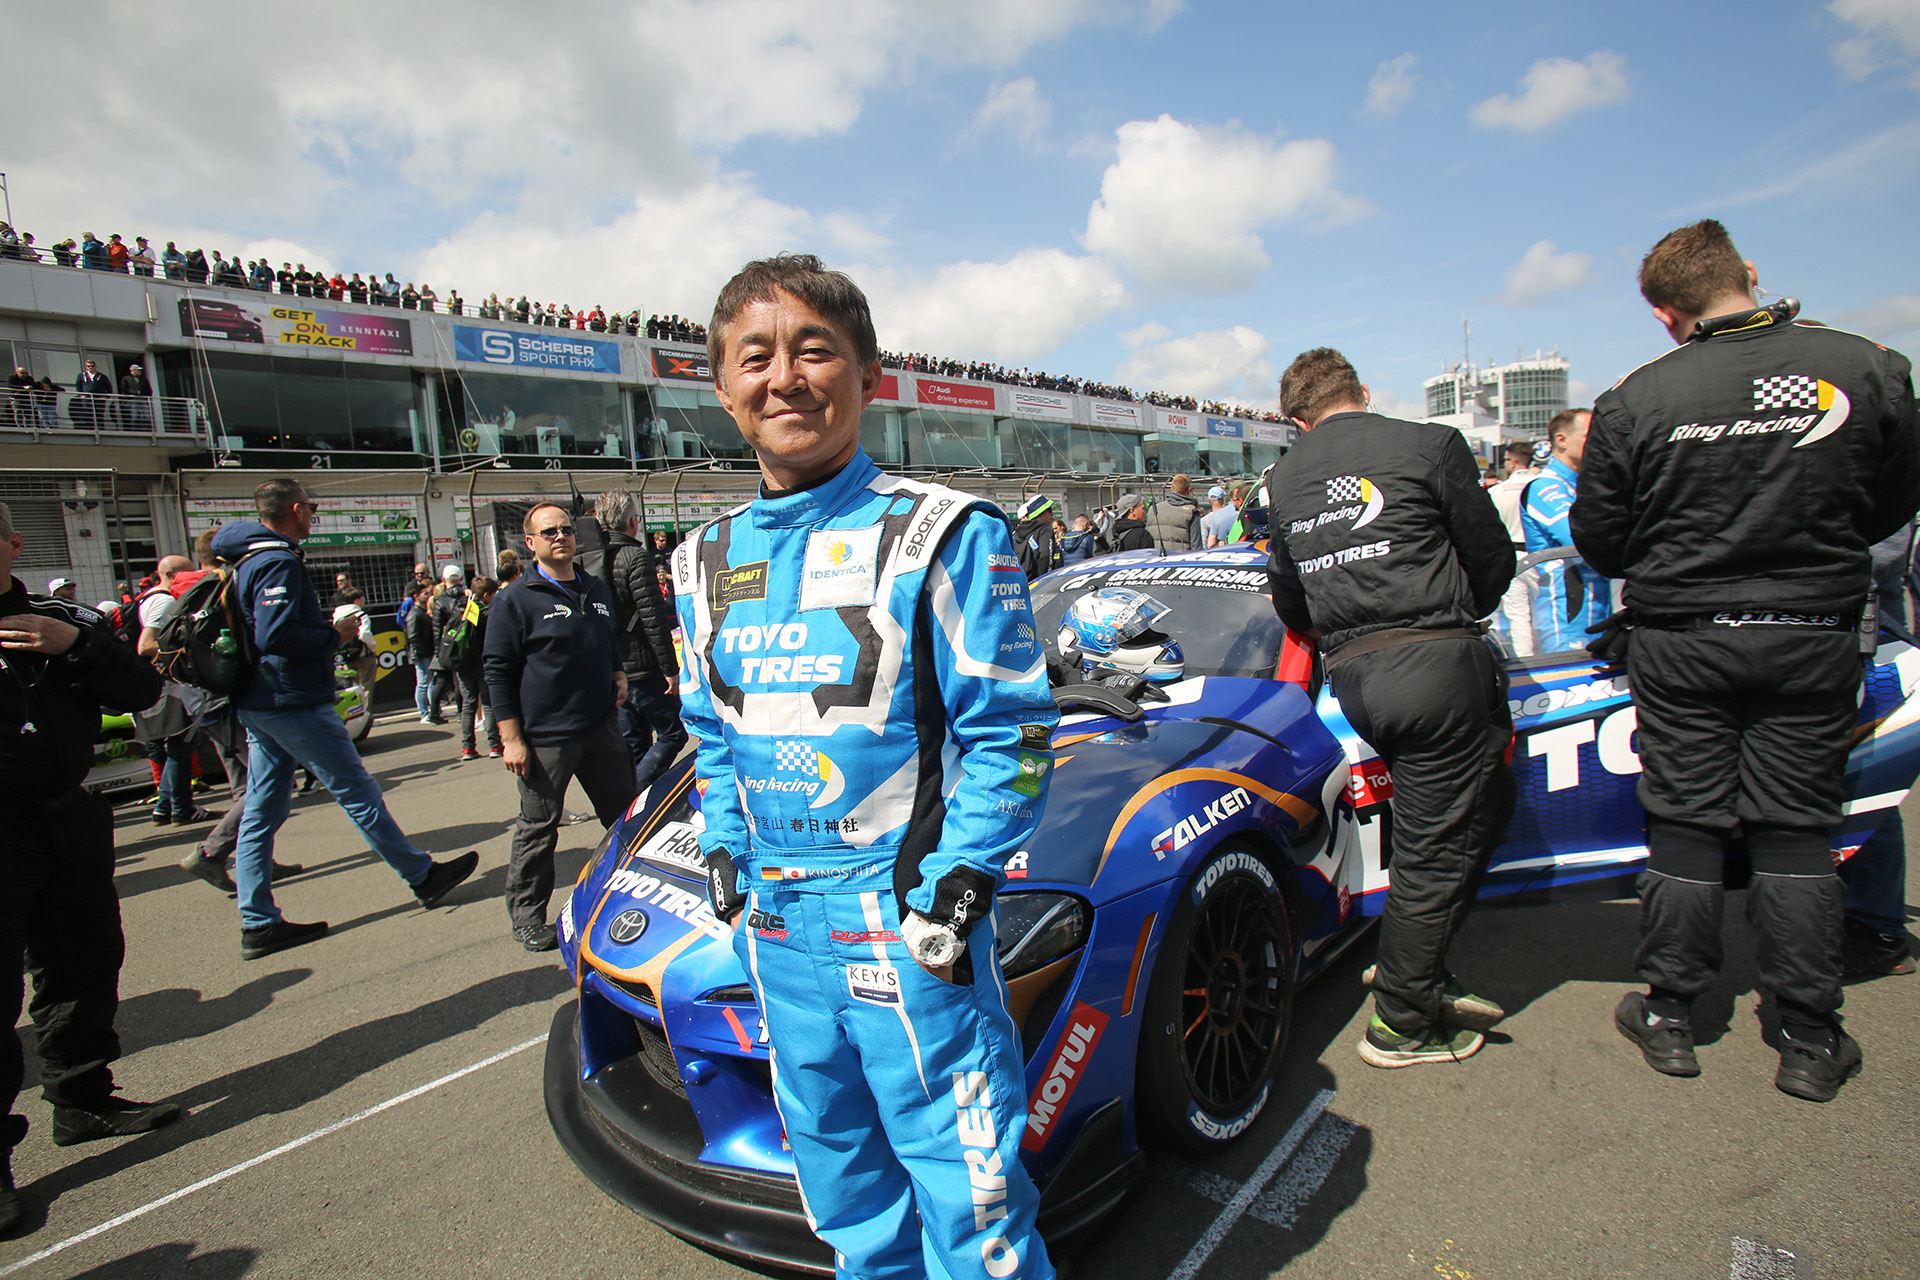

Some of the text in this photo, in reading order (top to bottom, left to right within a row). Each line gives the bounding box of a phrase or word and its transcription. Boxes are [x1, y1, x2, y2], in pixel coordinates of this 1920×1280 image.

[273, 308, 312, 320] GET
[296, 323, 324, 334] ON
[340, 325, 400, 338] RENNTAXI
[284, 332, 353, 348] TRACK
[518, 338, 594, 356] SCHERER
[520, 352, 595, 368] SPORT PHX
[936, 386, 950, 394] Audi
[937, 394, 988, 406] driving experience
[1016, 394, 1062, 406] PORSCHE
[1096, 404, 1134, 414] PORSCHE
[1168, 414, 1188, 426] ROWE
[1667, 414, 1818, 442] Ring Racing
[312, 456, 332, 469] 21
[545, 459, 562, 470] 20
[209, 518, 222, 526] 74
[310, 516, 320, 524] 01
[403, 517, 418, 530] 21
[1290, 504, 1364, 534] Ring Racing
[904, 498, 956, 560] sparco
[1298, 540, 1392, 574] TOYO TIRES
[810, 564, 866, 579] IDENTICA
[1108, 567, 1269, 586] GRAN TURISMO
[991, 583, 1021, 596] TOYO
[1150, 580, 1192, 588] DRIVING
[1194, 582, 1260, 592] SIMULATOR
[1002, 598, 1026, 611] TIRES
[721, 622, 809, 654] TOYO
[1000, 640, 1032, 652] Ring Racing
[740, 655, 844, 684] TIRES
[1367, 771, 1393, 788] Tot
[1150, 786, 1252, 862] FALKEN
[808, 864, 880, 879] KINOSHITA
[1196, 852, 1274, 900] TOYO TIRES
[603, 868, 658, 899] TOYO
[830, 930, 902, 942] DIXCEL
[1027, 1021, 1096, 1137] MOTUL
[952, 1070, 1009, 1232] TIRES
